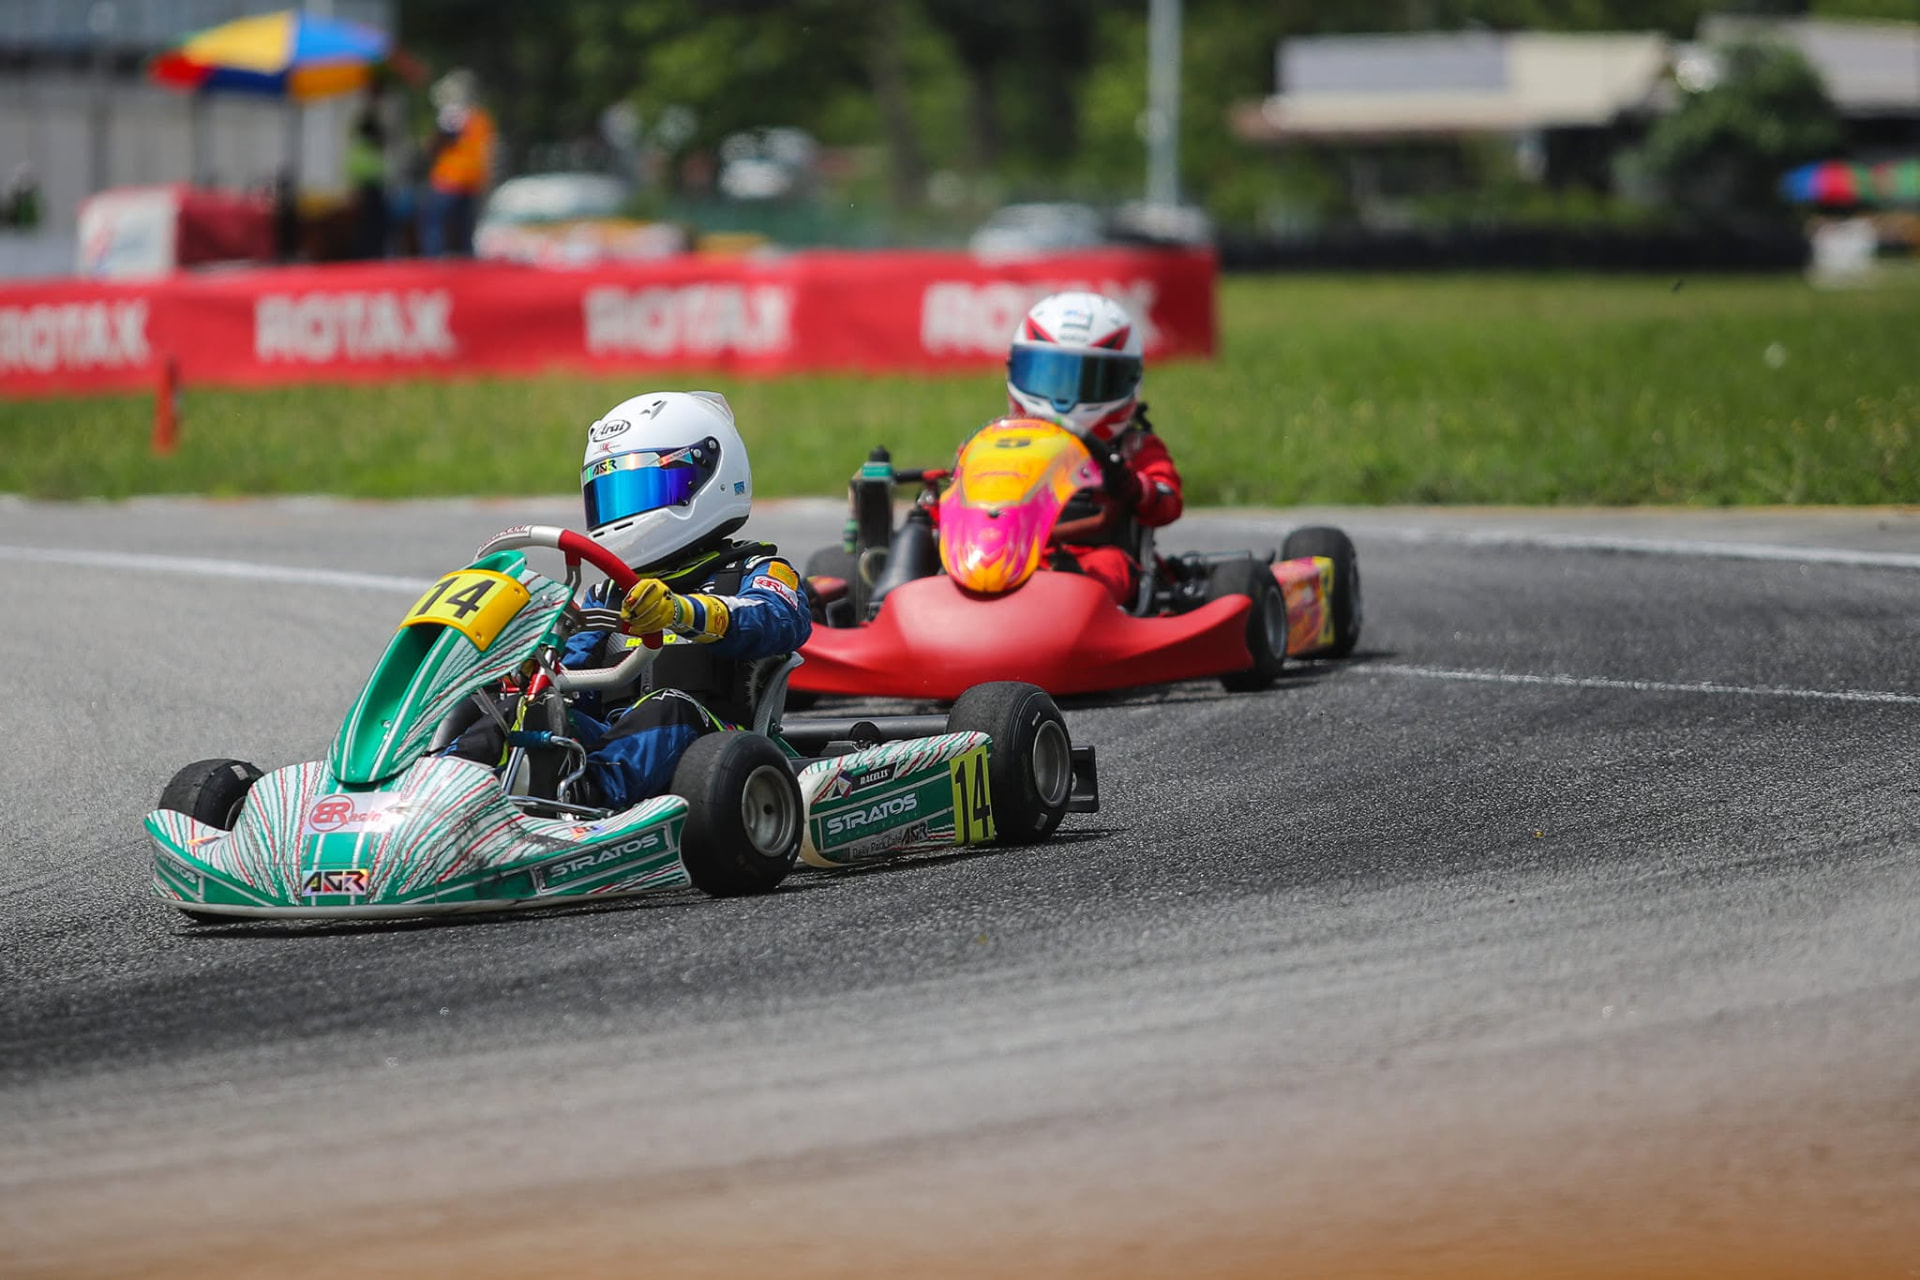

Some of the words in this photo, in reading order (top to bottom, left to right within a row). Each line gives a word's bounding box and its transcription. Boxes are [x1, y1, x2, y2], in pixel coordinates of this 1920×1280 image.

[253, 289, 457, 363] ROTAX
[584, 281, 796, 358] ROTAX
[599, 421, 626, 436] Arai
[415, 576, 496, 619] 14
[826, 792, 918, 836] STRATOS
[954, 753, 992, 845] 14
[549, 833, 660, 878] STRATOS
